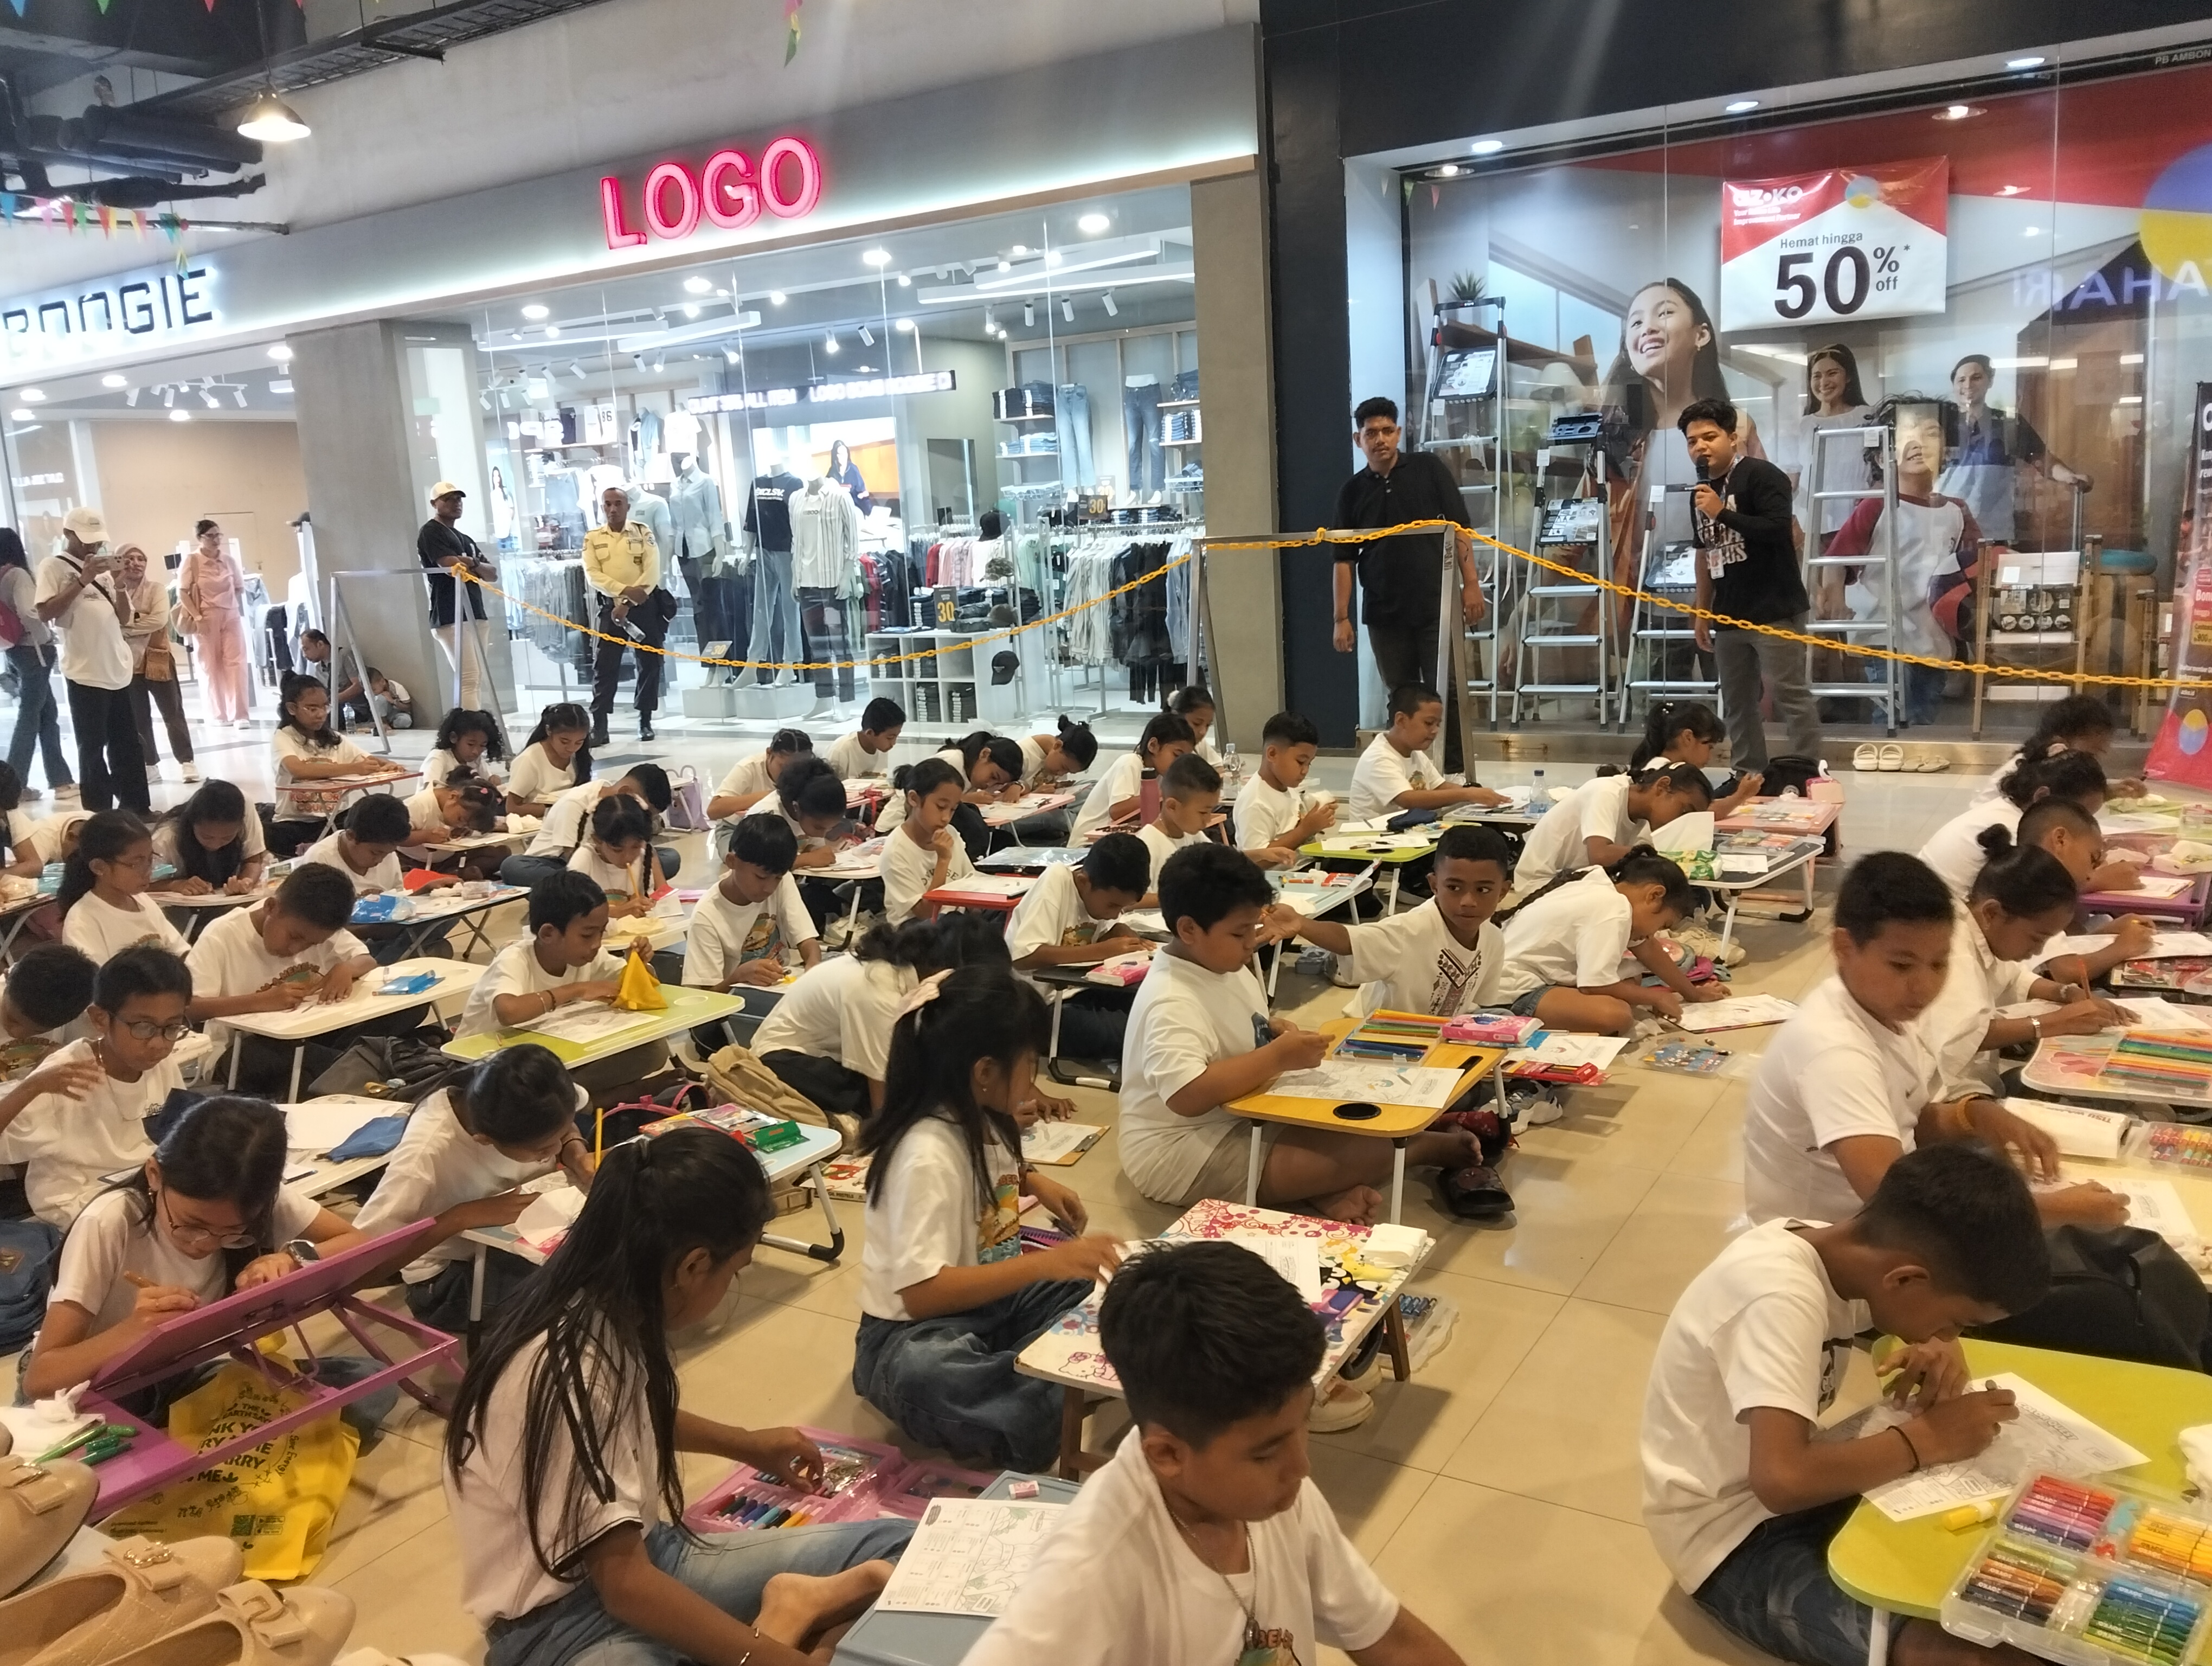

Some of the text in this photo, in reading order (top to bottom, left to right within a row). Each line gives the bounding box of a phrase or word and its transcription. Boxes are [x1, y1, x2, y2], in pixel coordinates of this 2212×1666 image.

[2172, 49, 2211, 62] AMBON
[601, 137, 821, 250] LOGO
[1780, 232, 1863, 249] Hemat hingga
[1876, 275, 1899, 292] off
[937, 601, 955, 623] 30
[2087, 1113, 2112, 1124] TISU
[2047, 1417, 2079, 1440] QUEST
[197, 1469, 223, 1483] ME
[1978, 1581, 2002, 1593] JOYKO
[2117, 1586, 2143, 1598] JOYKO
